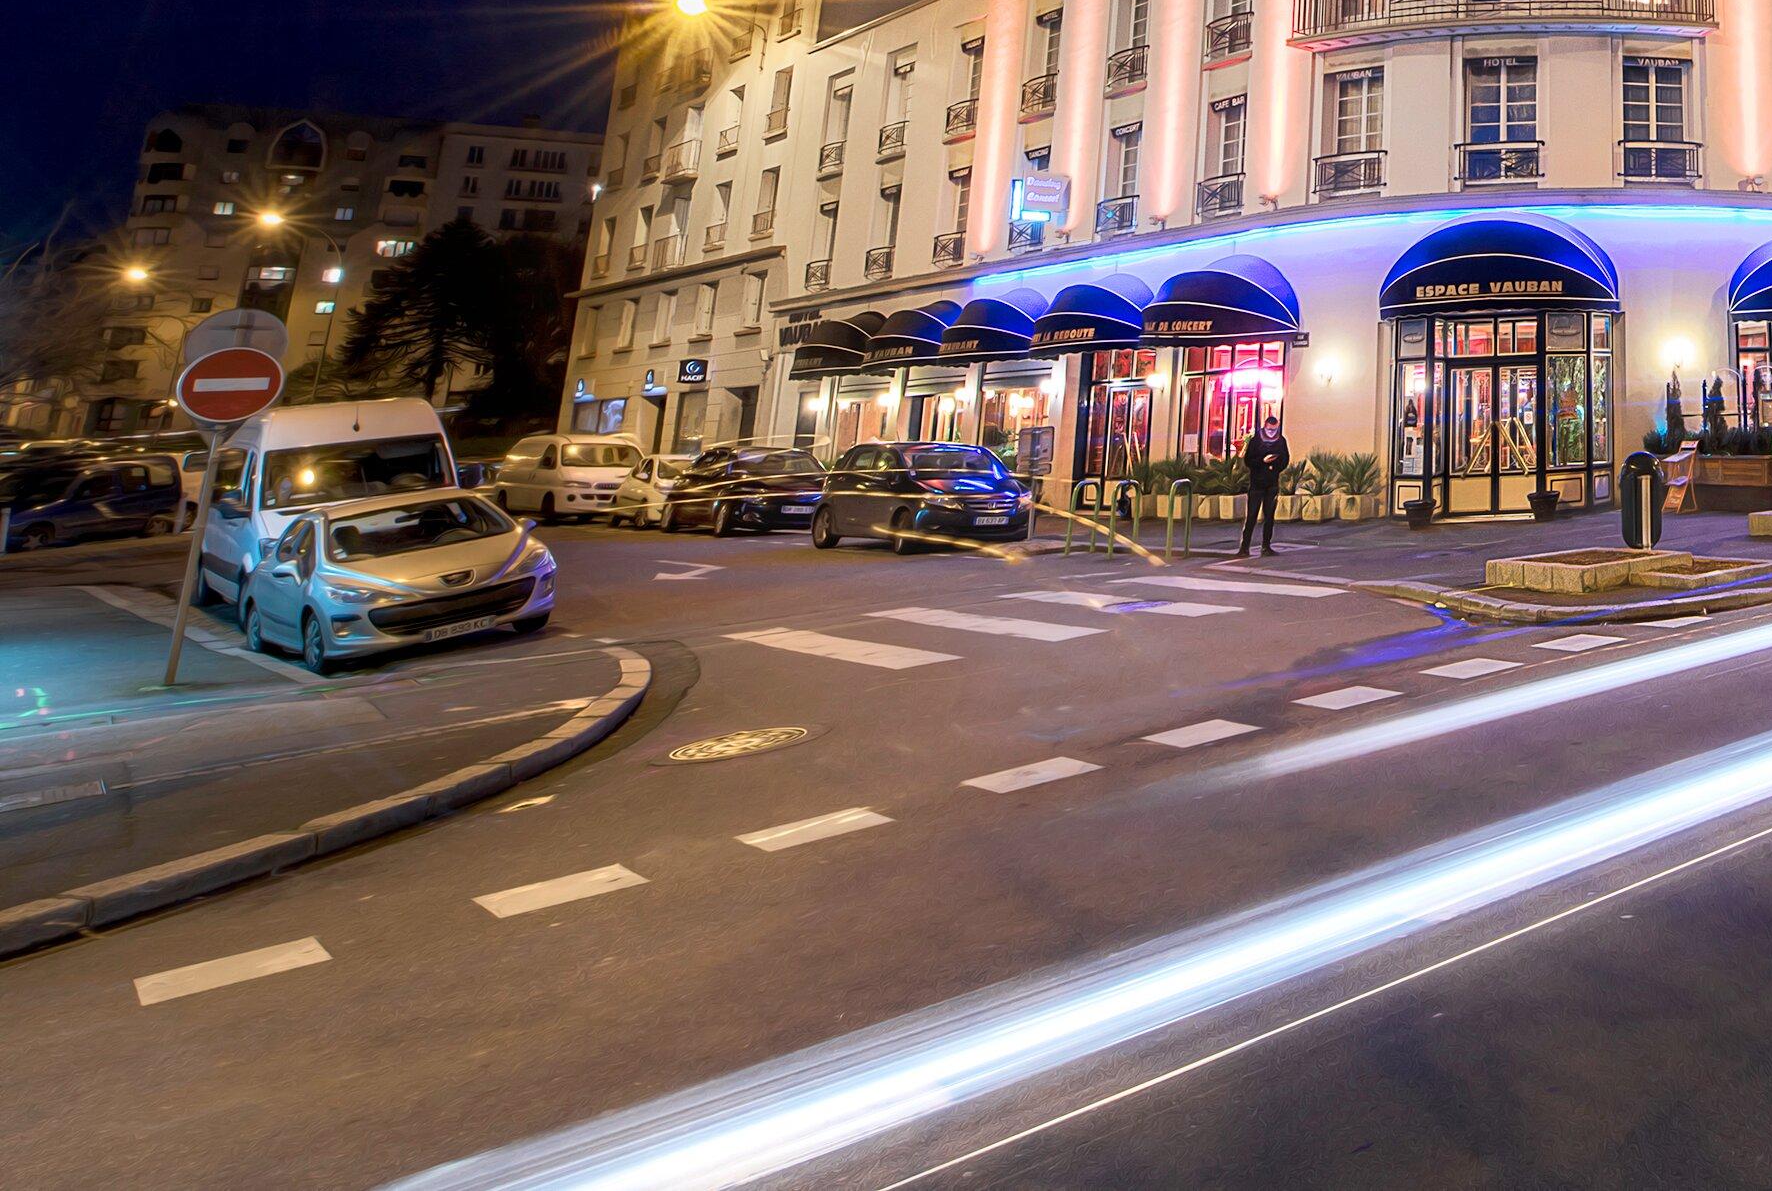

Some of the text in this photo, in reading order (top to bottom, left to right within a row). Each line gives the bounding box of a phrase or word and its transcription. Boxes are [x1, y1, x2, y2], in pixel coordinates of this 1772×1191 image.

[1483, 57, 1518, 68] HOTEL
[1637, 58, 1679, 67] VAUBAN
[1335, 69, 1373, 82] VAUBAN
[1213, 95, 1246, 111] CAFE BAR
[1115, 122, 1141, 137] CONCERT
[1416, 280, 1563, 298] ESPACE VAUBAN
[1171, 321, 1213, 331] CONCERT
[1054, 328, 1096, 340] REDOUTE
[874, 345, 914, 359] VAUBAN
